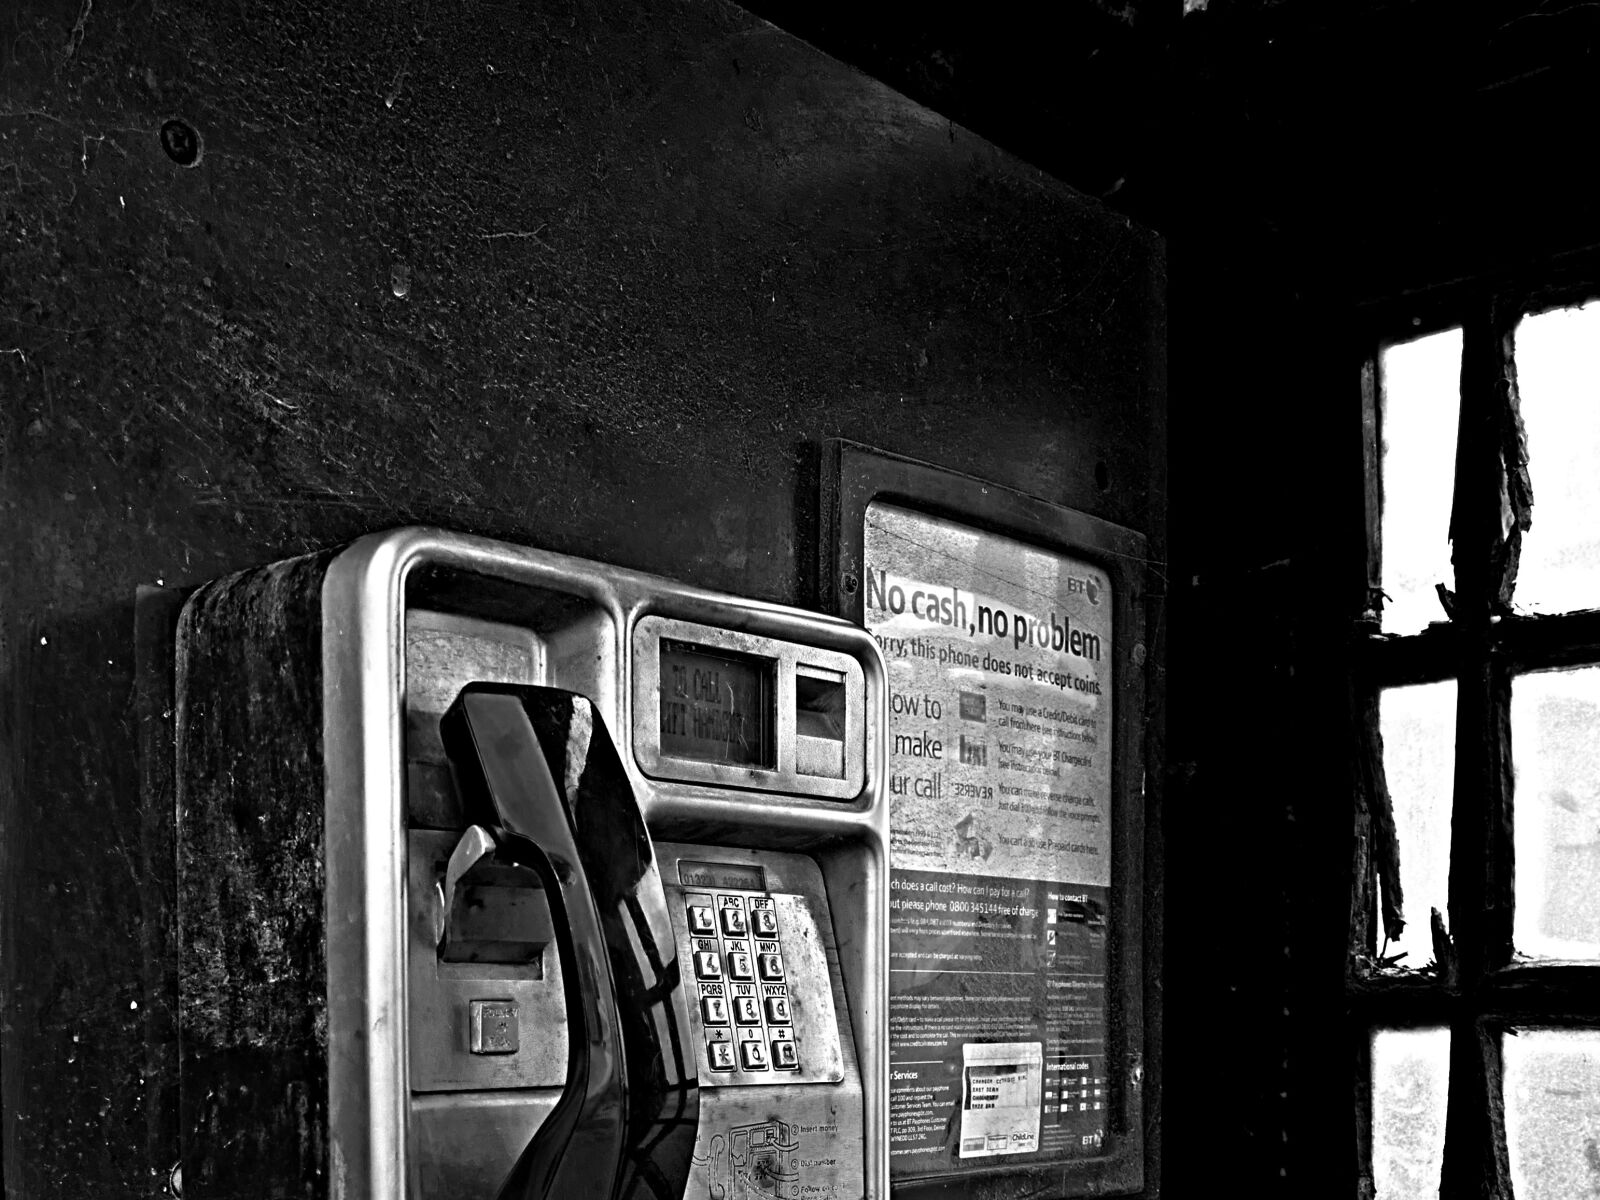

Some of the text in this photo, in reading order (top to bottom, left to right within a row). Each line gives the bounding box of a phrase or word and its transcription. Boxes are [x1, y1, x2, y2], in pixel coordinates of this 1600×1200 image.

[1067, 577, 1085, 593] BT
[866, 567, 1101, 662] No cash, no problem
[870, 630, 1103, 697] orry, this phone does not accept coins.
[694, 667, 722, 705] CALL
[890, 693, 942, 720] ow to
[998, 699, 1010, 712] You
[998, 716, 1009, 727] call
[895, 730, 943, 760] make
[998, 740, 1010, 754] You
[890, 772, 942, 800] ur call
[998, 782, 1010, 796] You
[998, 833, 1009, 845] You
[901, 879, 920, 892] does
[925, 881, 938, 893] call
[957, 884, 972, 895] How
[901, 900, 924, 912] please
[926, 900, 947, 913] phone
[949, 901, 970, 913] 0800
[697, 940, 777, 953] GHI JKL MNO
[701, 984, 786, 996] PQRS TUV WXYZ
[1077, 1061, 1089, 1070] codes
[893, 1070, 919, 1080] Services
[801, 1125, 818, 1133] Insert
[819, 1123, 838, 1133] money
[1082, 1135, 1094, 1146] BT
